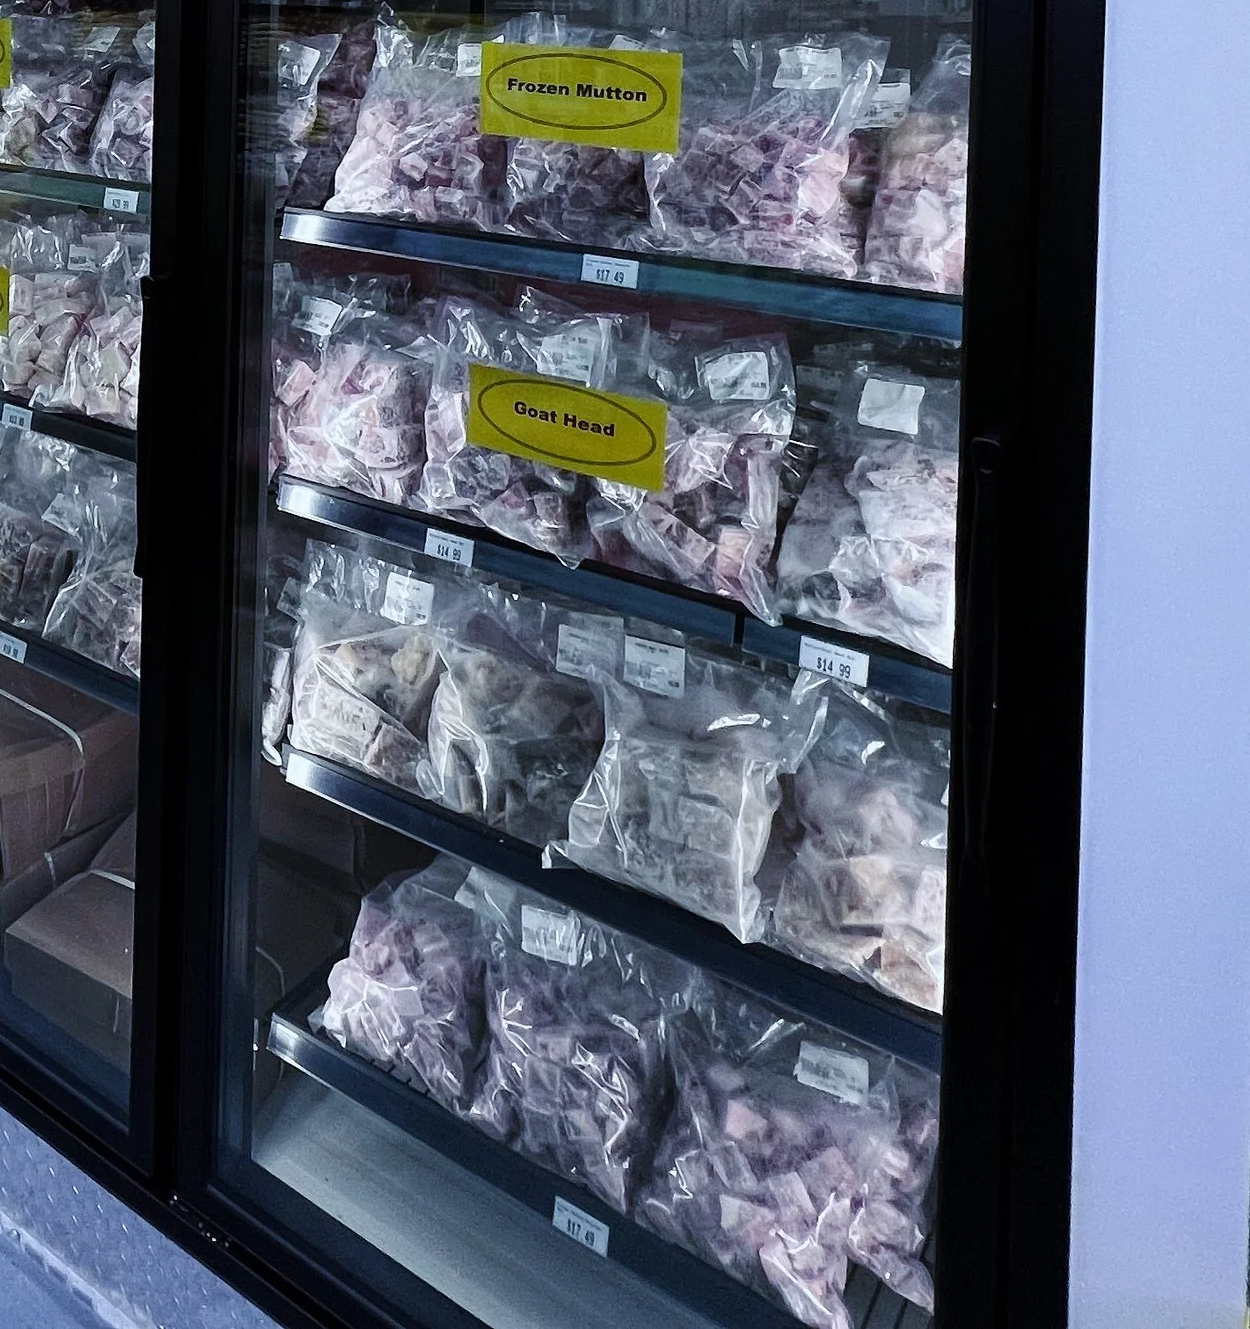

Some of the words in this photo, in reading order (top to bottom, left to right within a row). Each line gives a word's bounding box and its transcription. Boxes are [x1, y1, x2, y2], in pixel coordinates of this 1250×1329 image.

[506, 77, 570, 96] Frozen
[576, 83, 647, 102] Mutton
[514, 401, 558, 424] Goat
[563, 413, 615, 438] Head
